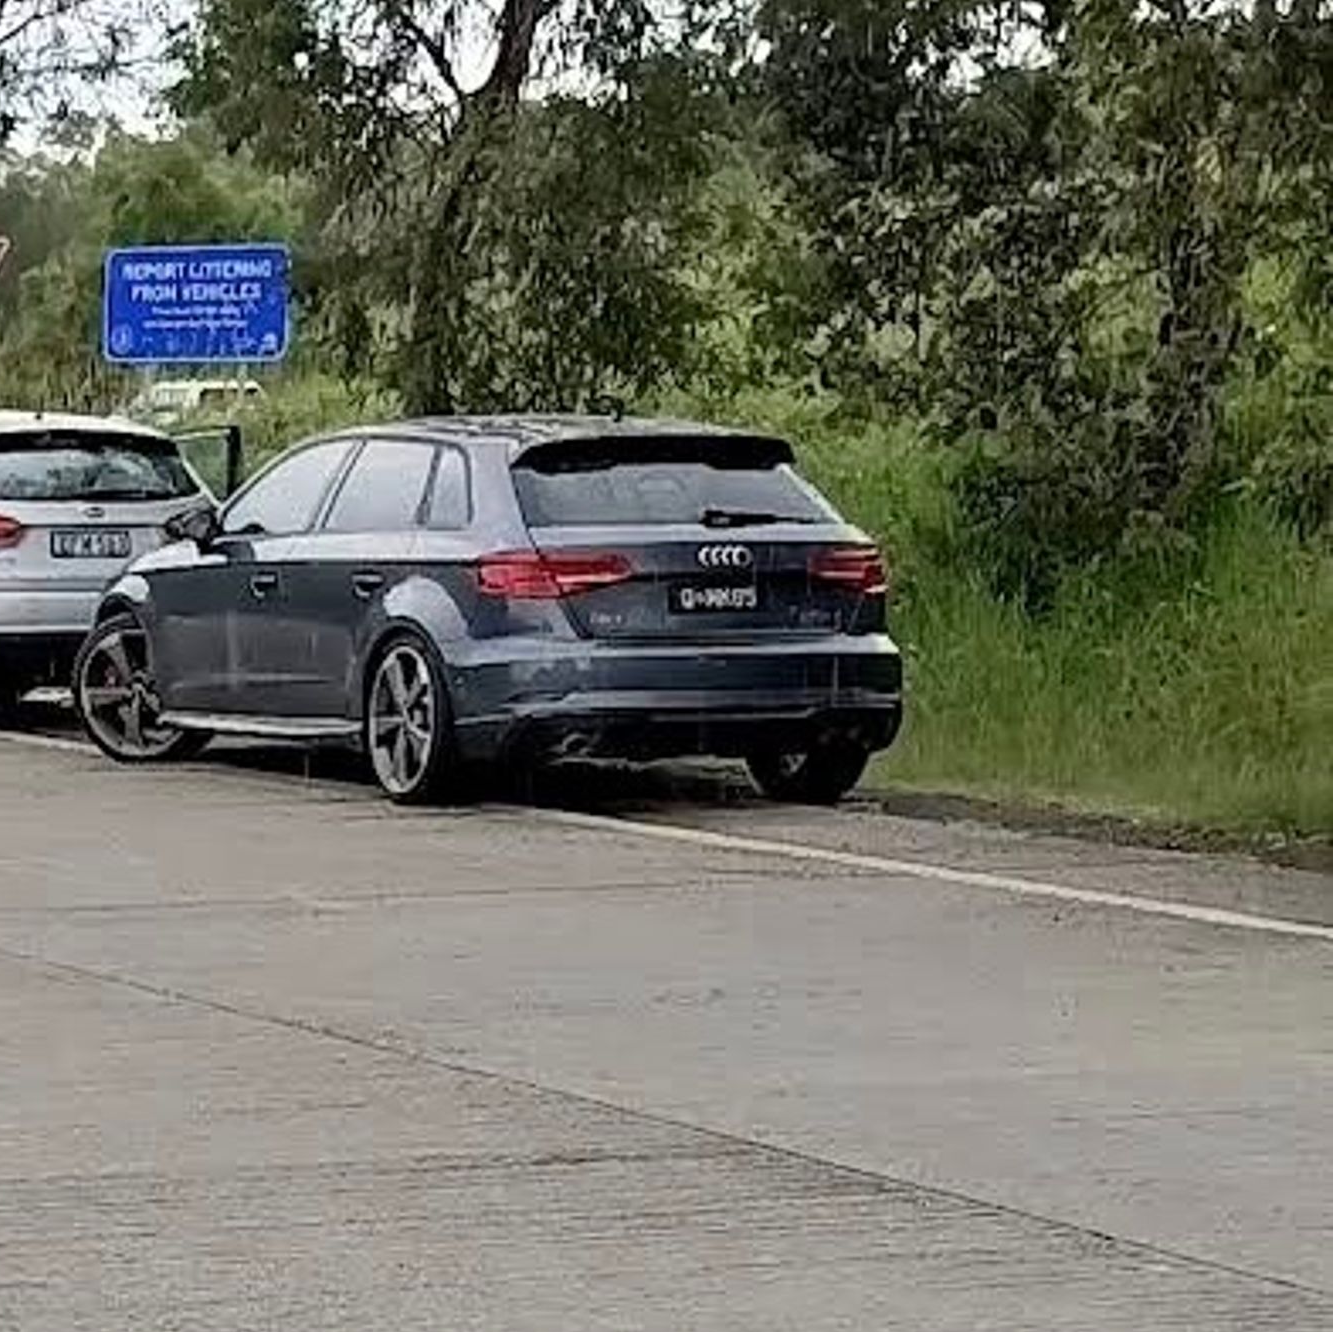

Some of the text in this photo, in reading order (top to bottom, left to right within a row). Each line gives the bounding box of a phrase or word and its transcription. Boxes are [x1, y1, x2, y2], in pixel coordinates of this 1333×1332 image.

[123, 263, 186, 280] REPORT
[131, 283, 262, 301] FROM VEHICLES
